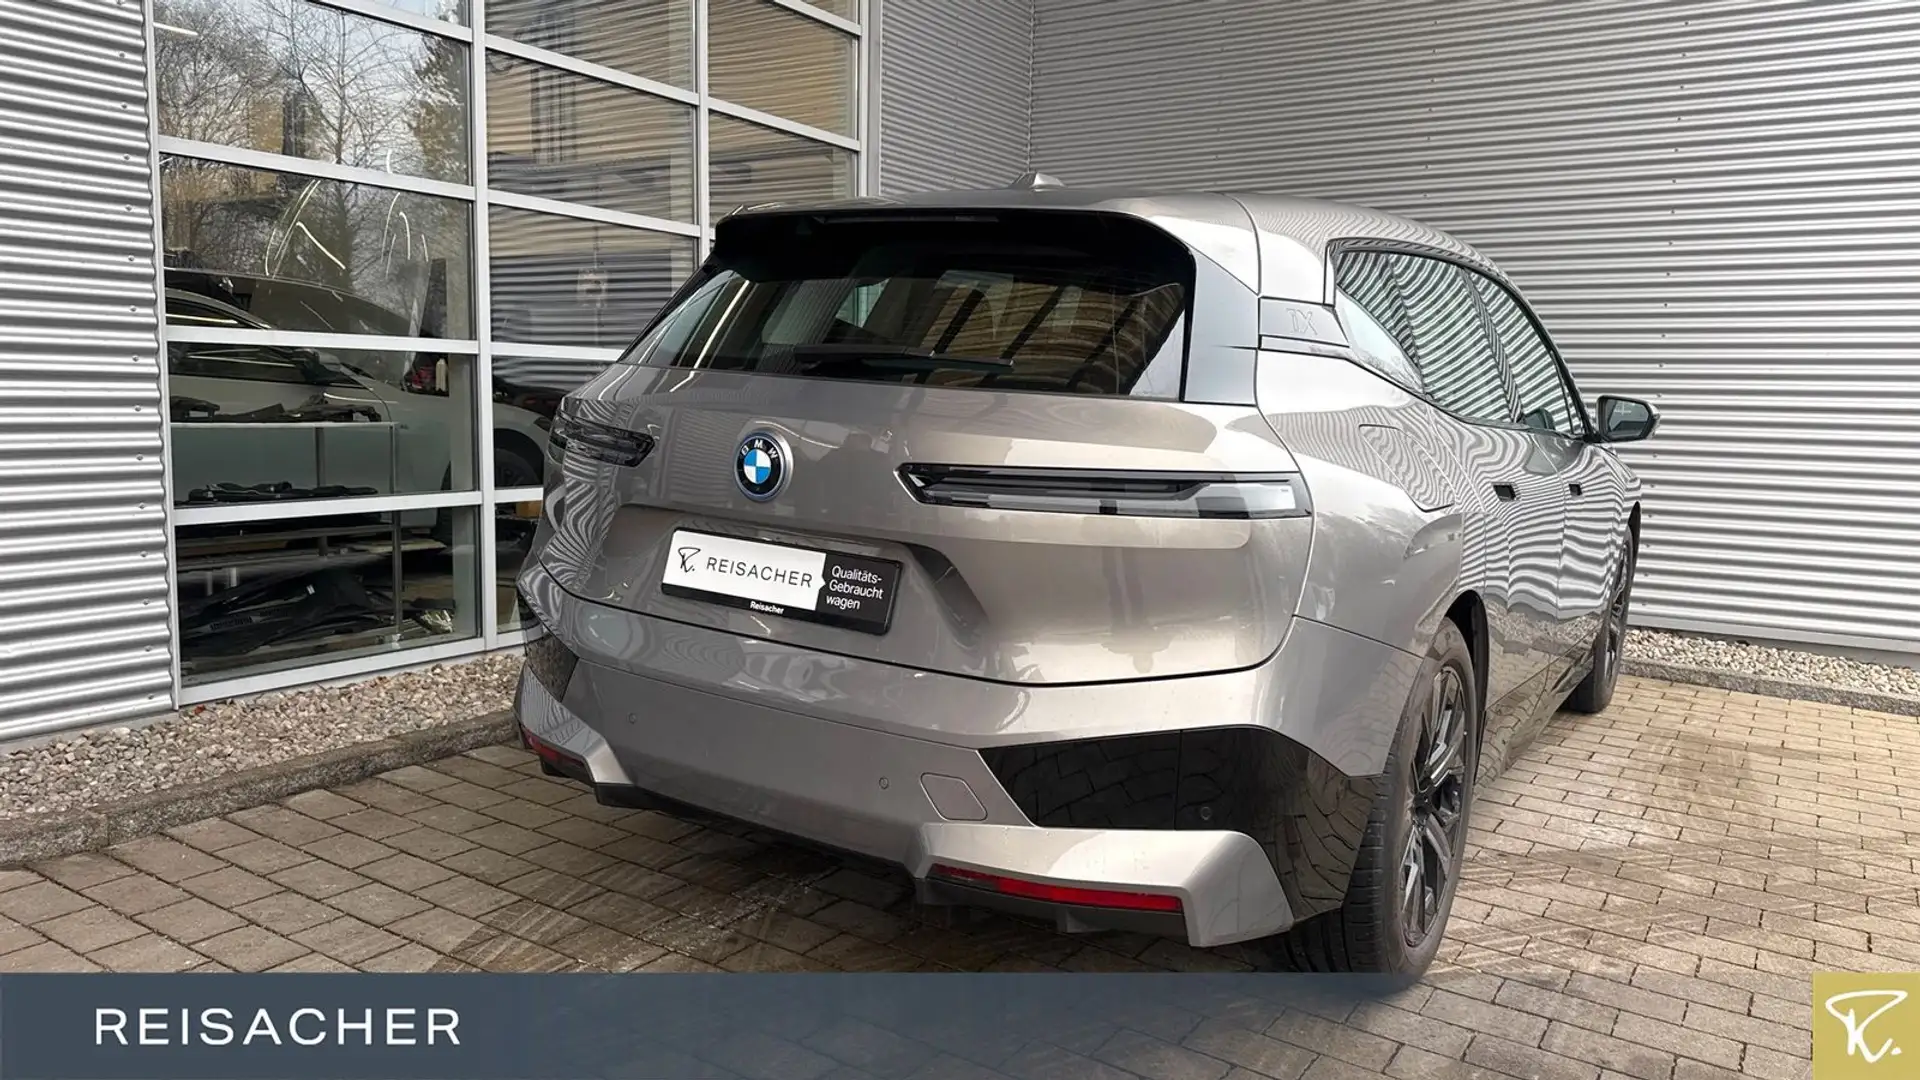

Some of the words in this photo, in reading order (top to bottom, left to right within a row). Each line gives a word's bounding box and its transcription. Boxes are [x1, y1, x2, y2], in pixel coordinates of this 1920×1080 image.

[706, 557, 813, 588] REISACHER
[831, 565, 883, 584] Qualitäts-
[829, 579, 884, 600] Gebraucht
[749, 600, 784, 615] Reisacher
[826, 595, 861, 610] wagen
